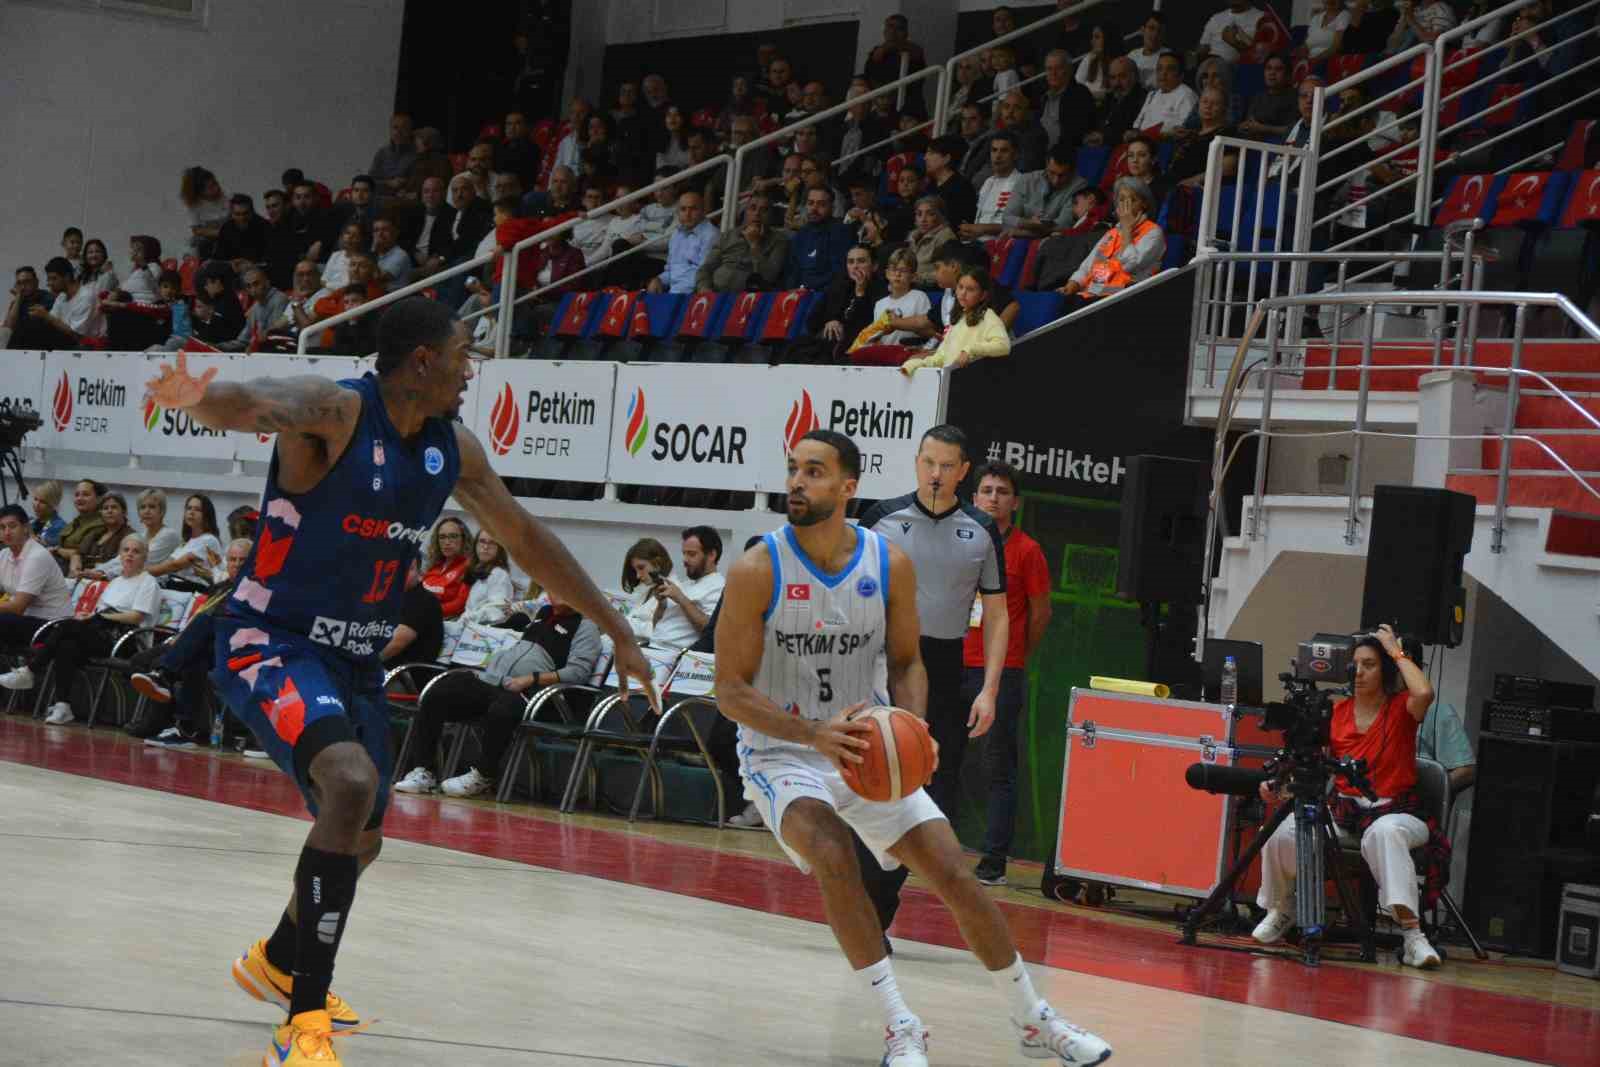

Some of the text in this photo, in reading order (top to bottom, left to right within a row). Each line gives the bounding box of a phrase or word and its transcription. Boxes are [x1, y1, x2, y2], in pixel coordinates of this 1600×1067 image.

[78, 377, 126, 407] Petkim
[162, 408, 226, 437] SOC
[526, 390, 596, 426] Petkim
[829, 399, 914, 440] Petkim
[74, 416, 109, 433] SPOR
[521, 437, 571, 457] SPOR
[651, 422, 747, 465] SOCAR
[859, 453, 883, 474] OR
[362, 559, 400, 602] 13
[838, 630, 876, 656] SP
[1318, 646, 1325, 656] 5
[816, 667, 834, 702] 5
